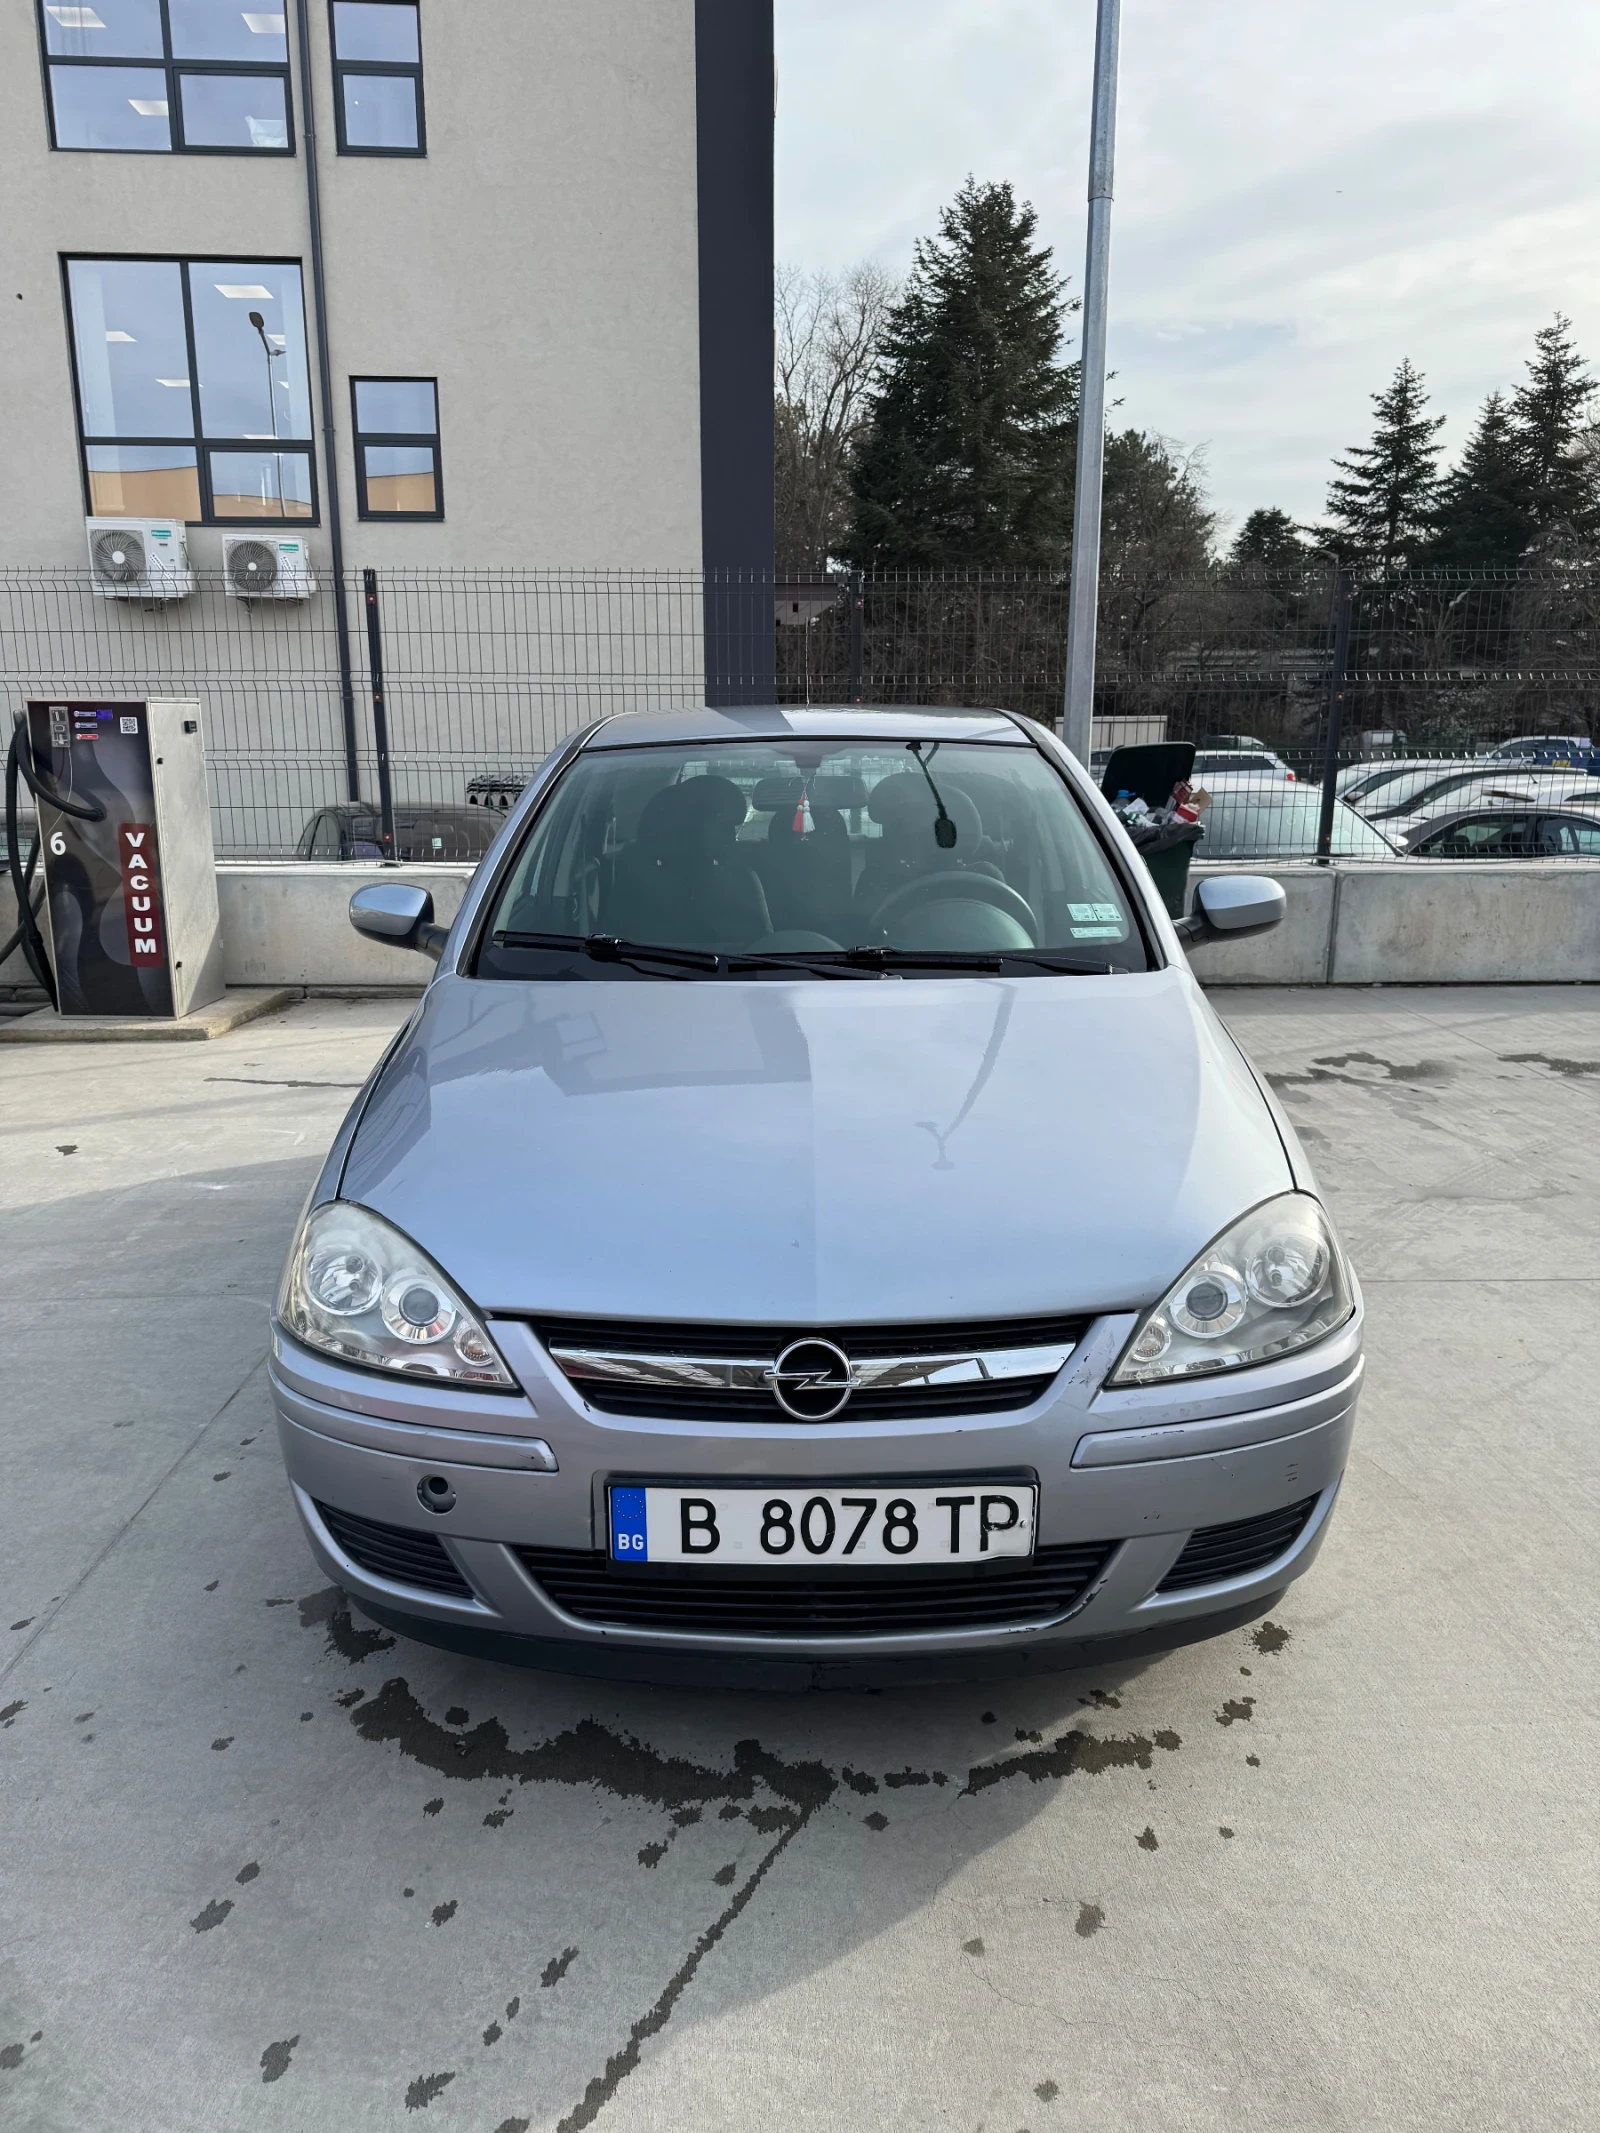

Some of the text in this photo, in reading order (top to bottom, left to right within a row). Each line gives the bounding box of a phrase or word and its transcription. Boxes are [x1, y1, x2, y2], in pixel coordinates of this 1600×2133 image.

[50, 831, 67, 856] 6
[125, 832, 156, 954] VACUUM
[618, 1534, 644, 1551] BG
[680, 1495, 1019, 1555] B 8078 TP
